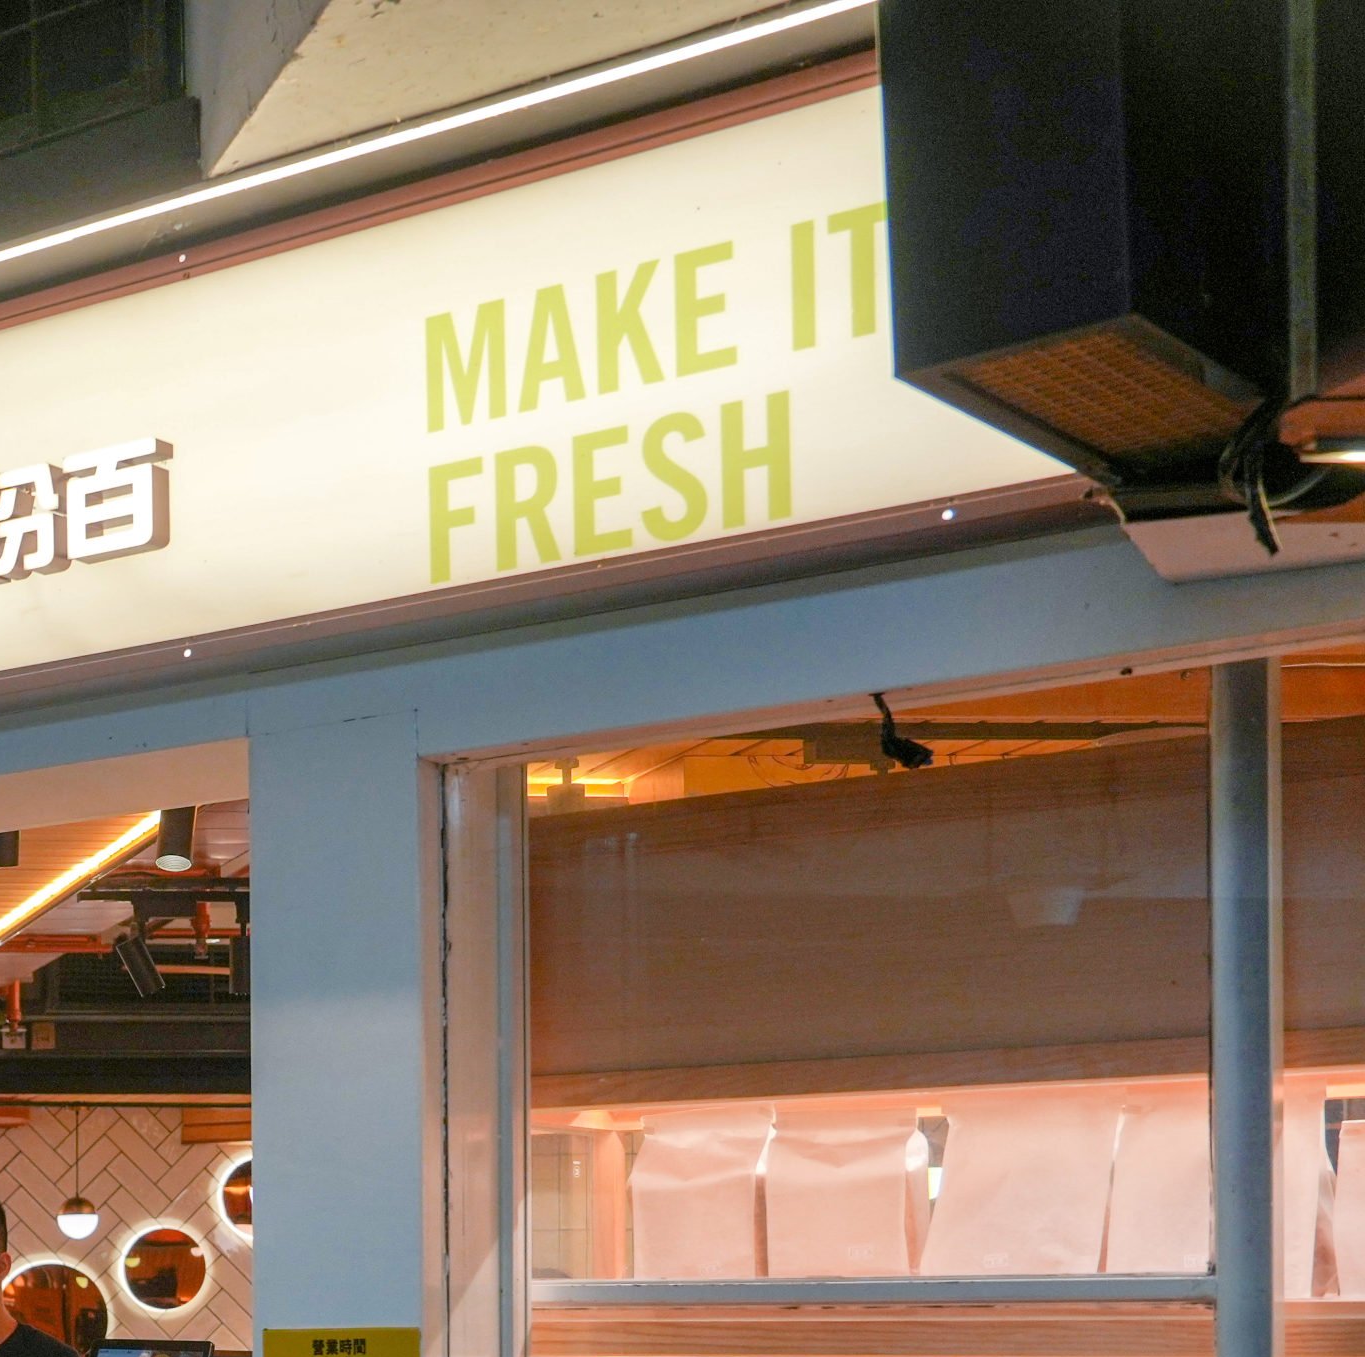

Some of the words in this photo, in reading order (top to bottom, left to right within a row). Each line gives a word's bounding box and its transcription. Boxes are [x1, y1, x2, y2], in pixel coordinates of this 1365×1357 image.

[424, 240, 737, 434] MAKE
[790, 201, 887, 351] IT
[428, 390, 794, 584] FRESH
[312, 1339, 367, 1356] 營業時間
